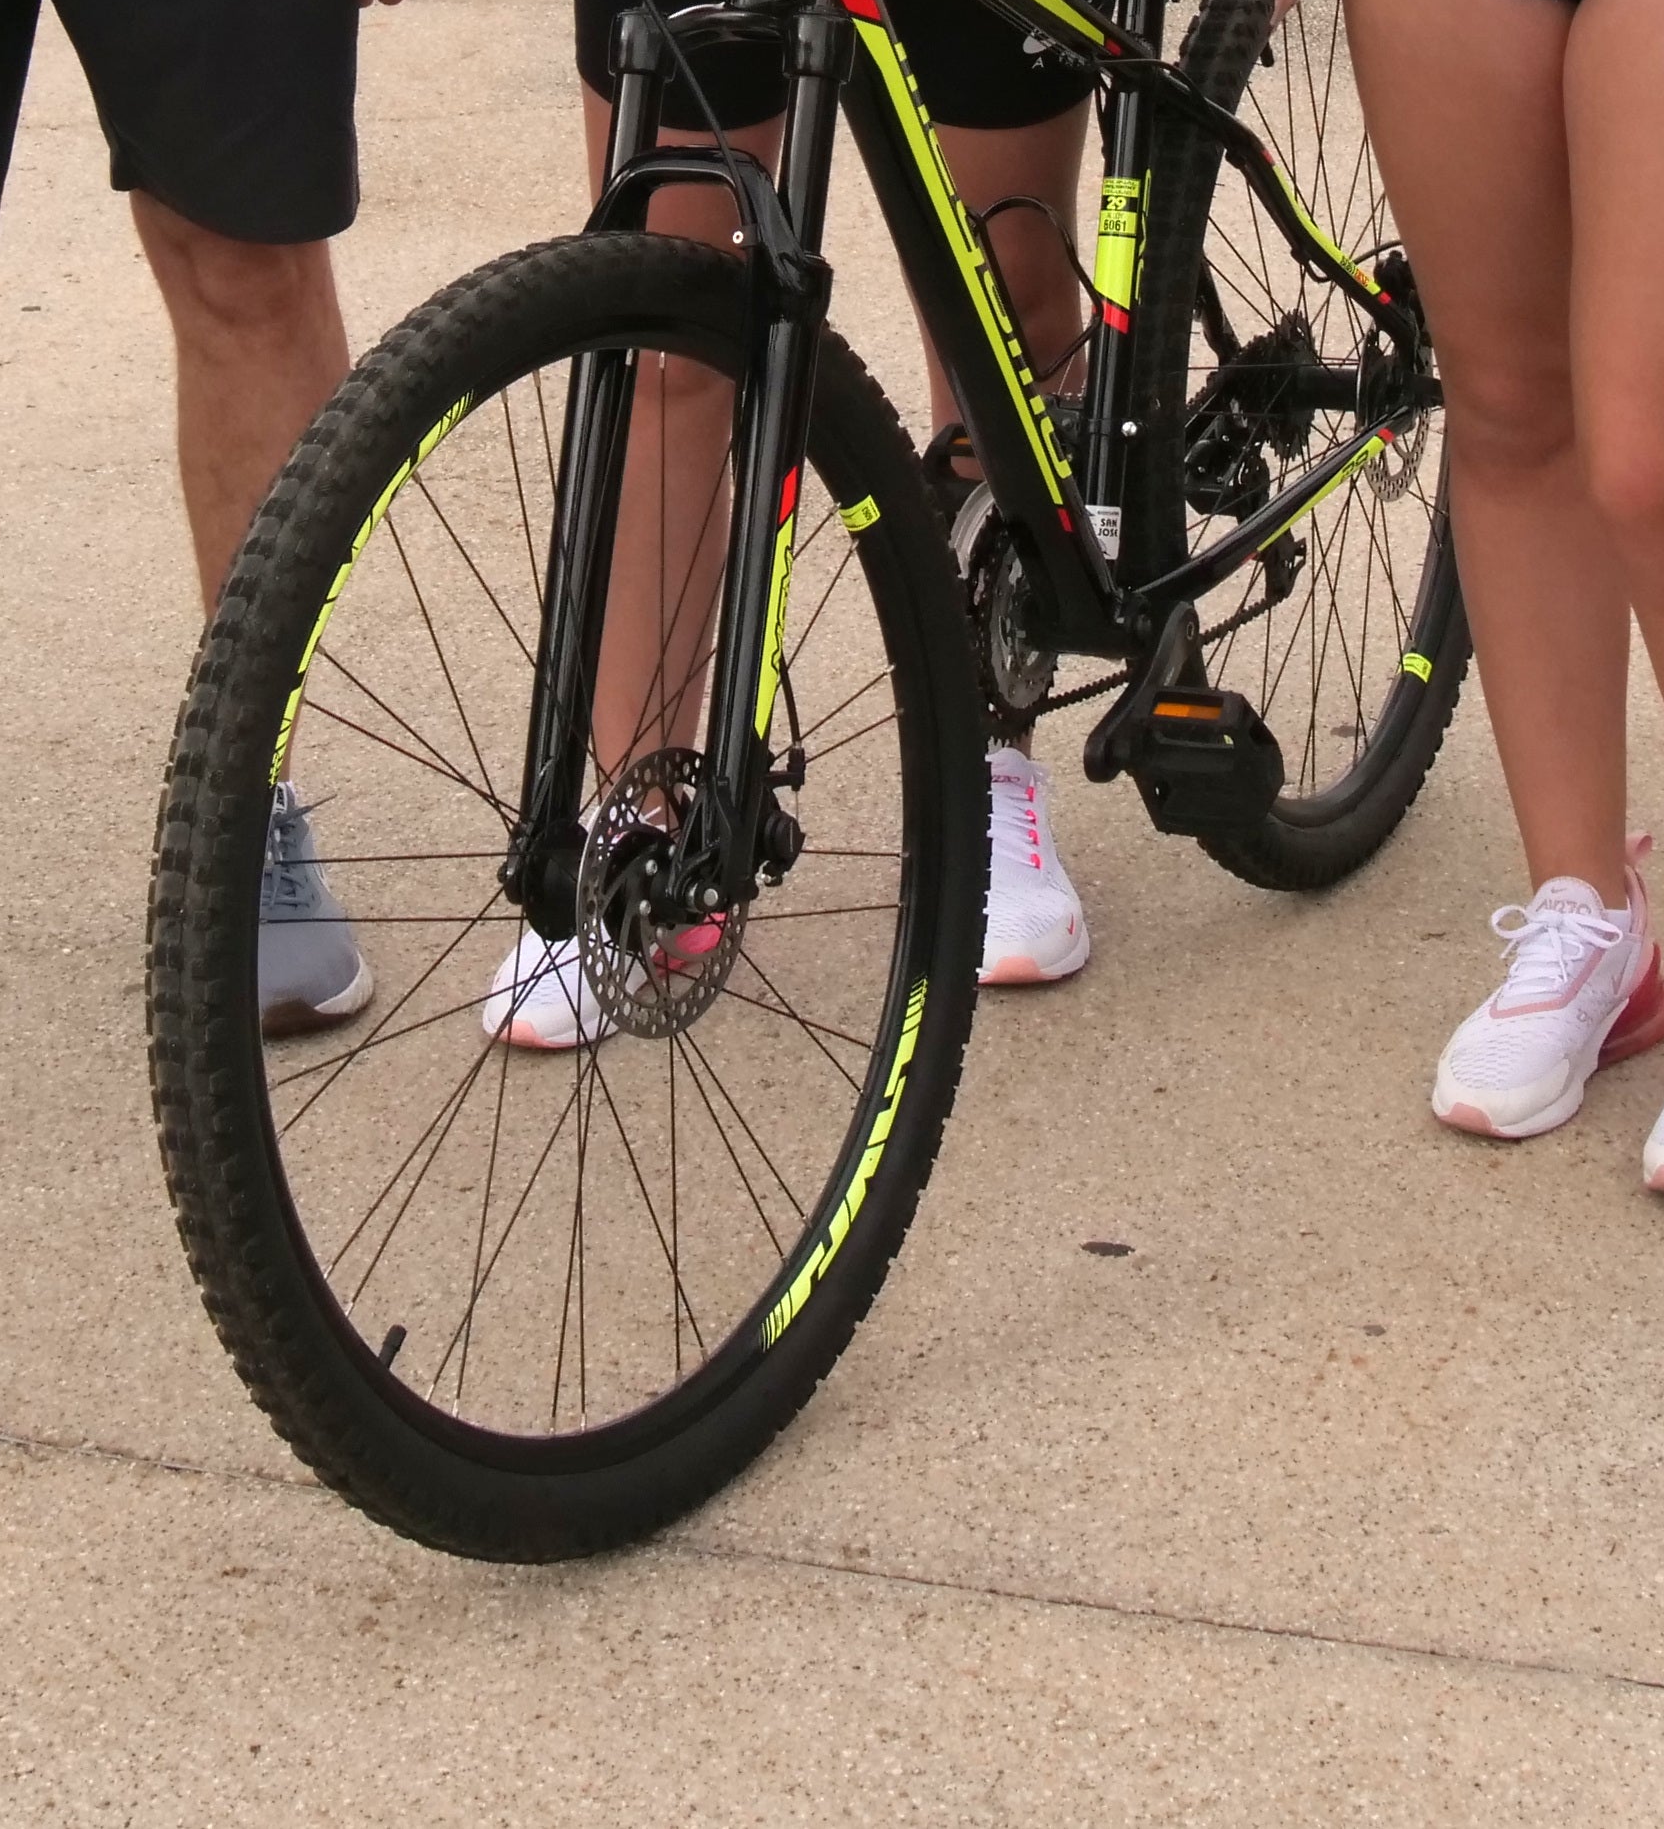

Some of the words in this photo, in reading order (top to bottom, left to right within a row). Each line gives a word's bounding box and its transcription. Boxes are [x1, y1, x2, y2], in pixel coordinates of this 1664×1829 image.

[1106, 196, 1127, 210] 29
[1103, 219, 1127, 232] 6061
[1100, 518, 1118, 528] SAN
[1098, 528, 1118, 538] JOSE
